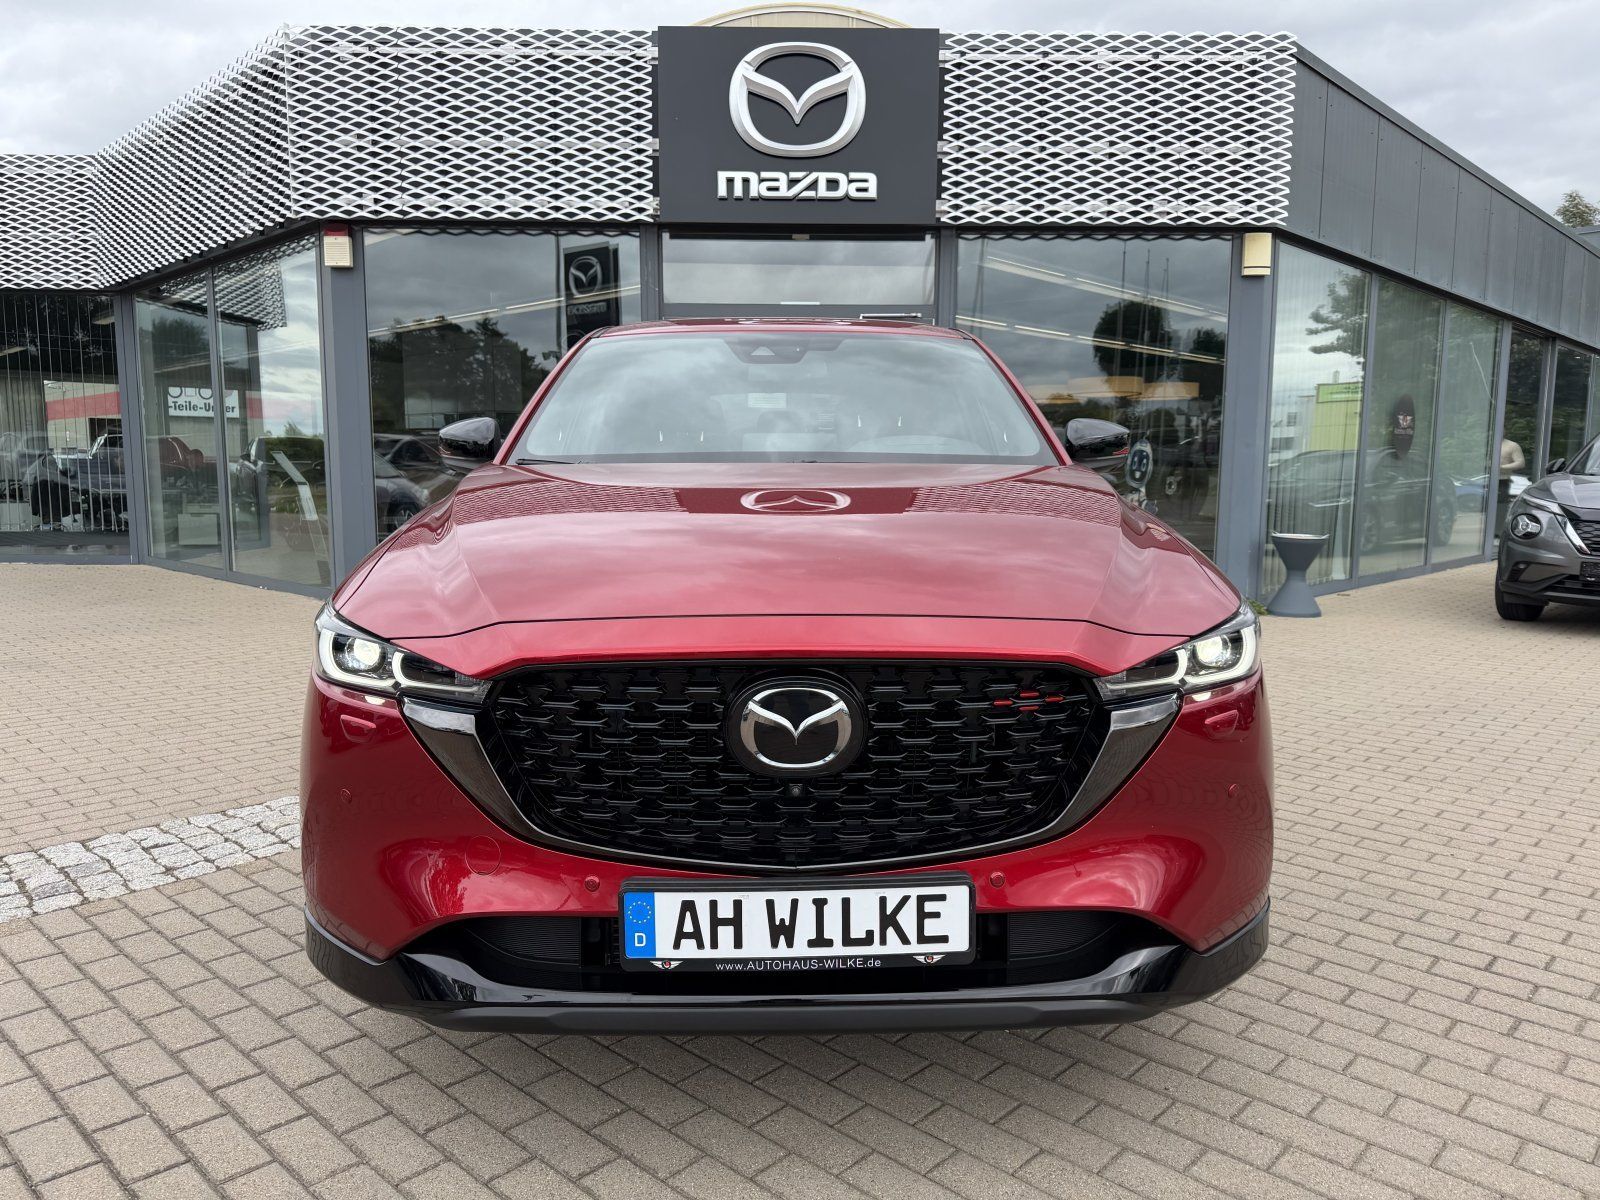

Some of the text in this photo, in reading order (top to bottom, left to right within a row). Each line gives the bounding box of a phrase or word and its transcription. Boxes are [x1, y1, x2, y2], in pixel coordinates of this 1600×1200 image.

[672, 894, 949, 950] AH WILKE
[634, 932, 646, 947] D
[715, 958, 882, 971] www.AUTOHAUS-WILKE.de
